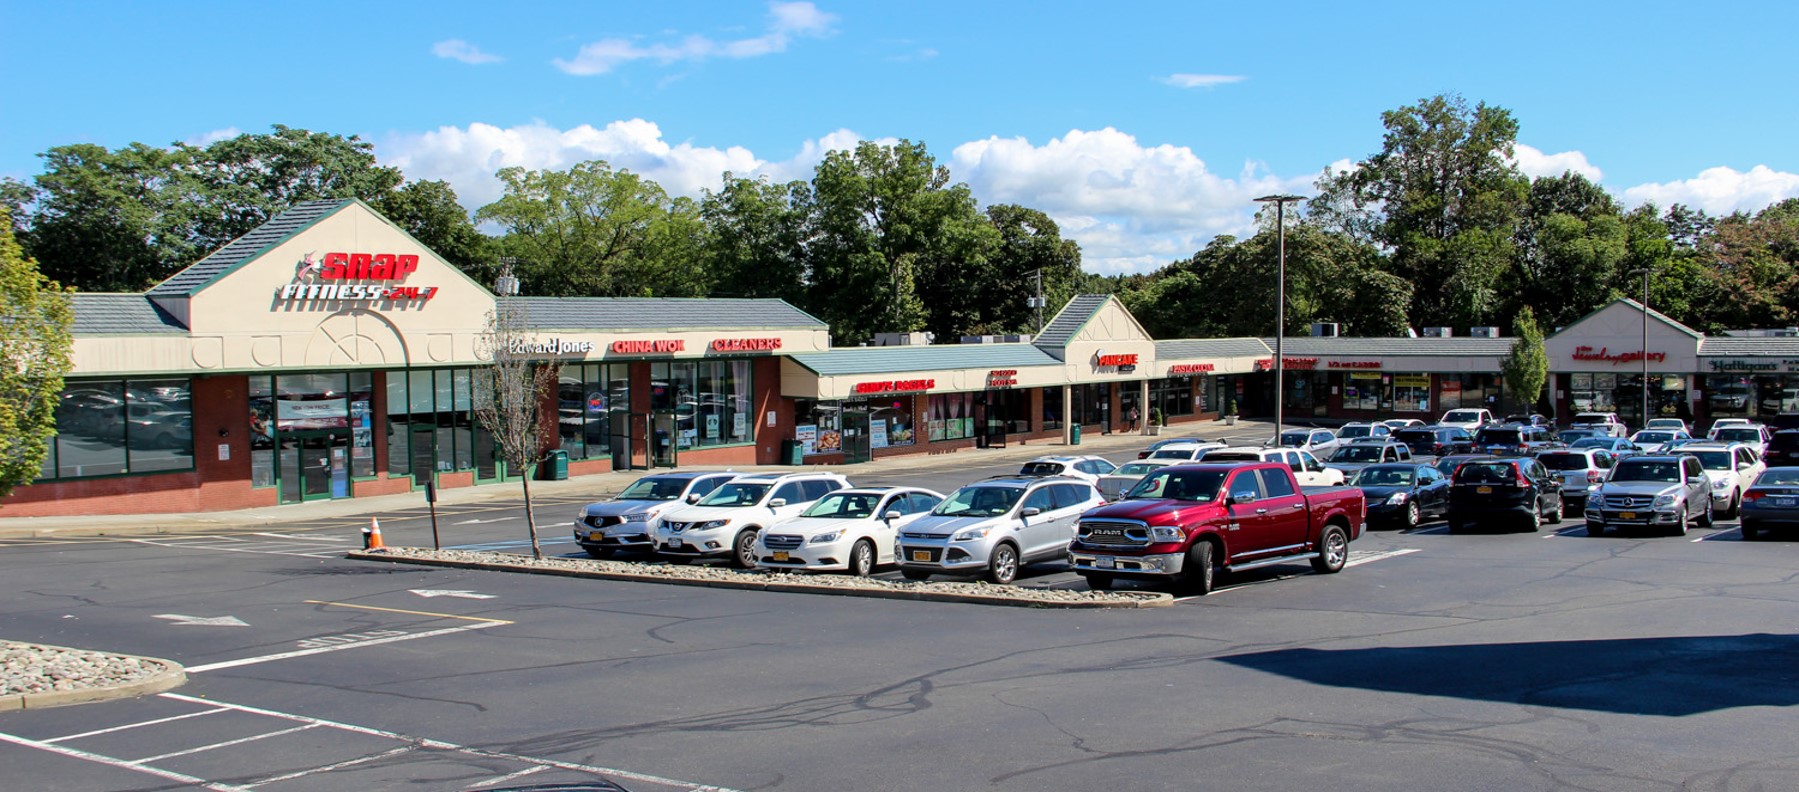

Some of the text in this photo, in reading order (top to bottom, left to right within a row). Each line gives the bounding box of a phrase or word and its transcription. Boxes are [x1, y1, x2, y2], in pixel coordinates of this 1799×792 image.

[281, 284, 383, 300] FITNESS
[557, 338, 596, 356] Jones
[612, 339, 686, 353] CHINA WOK
[712, 338, 783, 352] CLEANERS
[1098, 353, 1139, 366] PANCAKE
[1172, 364, 1192, 373] PASTA
